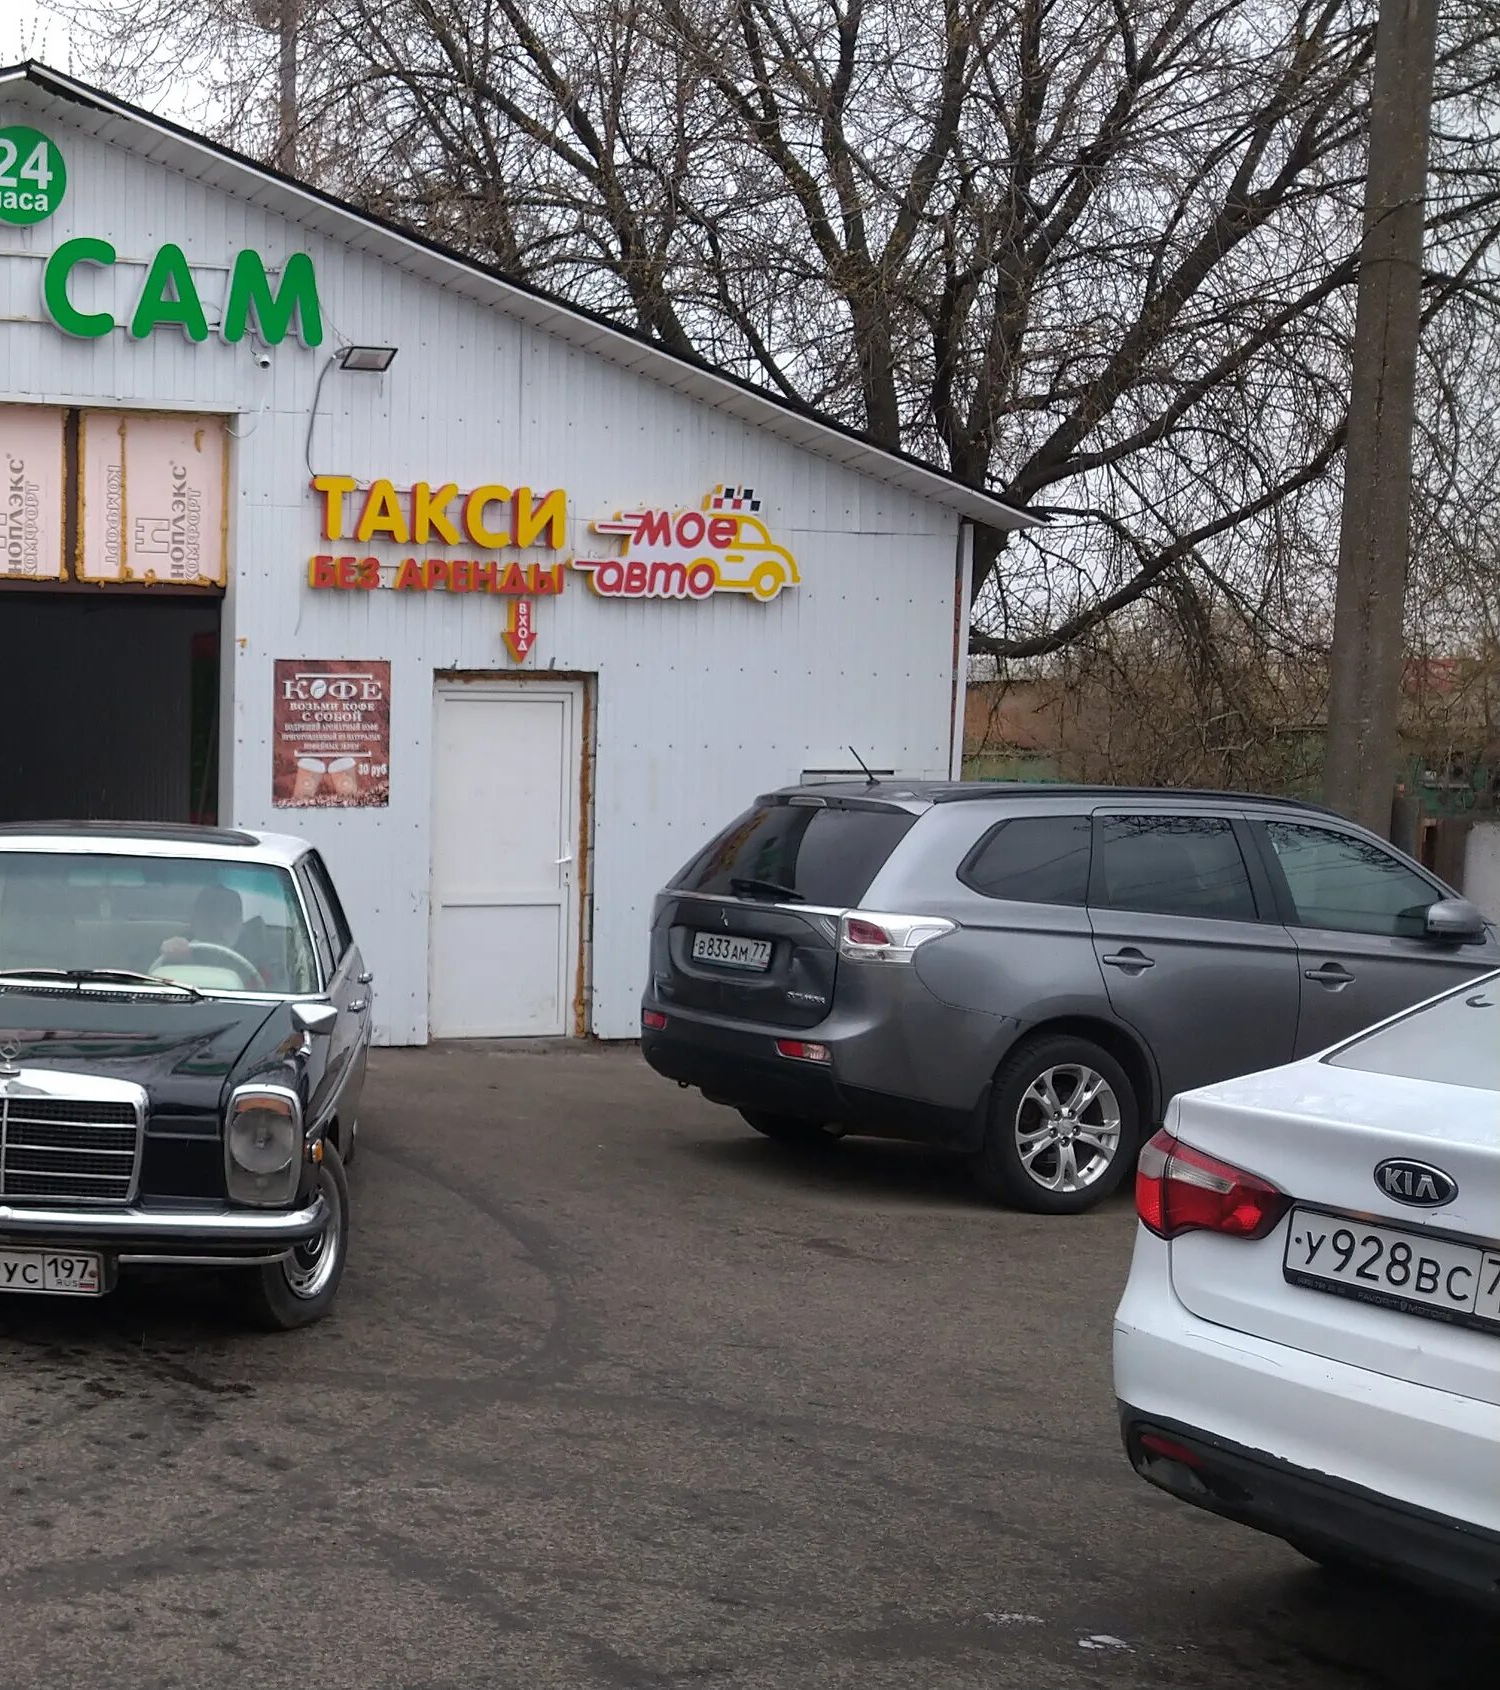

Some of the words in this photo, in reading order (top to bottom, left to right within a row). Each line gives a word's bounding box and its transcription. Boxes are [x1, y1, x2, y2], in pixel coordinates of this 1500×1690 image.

[43, 236, 323, 348] САМ
[171, 465, 187, 578] НОПЛЭКС
[310, 475, 566, 550] ТАКСИ
[309, 555, 380, 590] БЕЗ
[394, 558, 564, 595] АРЕНДЫ
[518, 602, 529, 651] ВХОД
[282, 679, 383, 700] КОФЕ
[289, 702, 339, 712] ВОЗЬМИ
[342, 702, 376, 712] КОФЕ
[302, 712, 311, 722] С
[314, 710, 363, 722] СОБОЙ
[698, 937, 749, 961] В833АМ
[752, 942, 767, 959] 77
[1384, 1167, 1439, 1200] KIA
[47, 1257, 90, 1279] 197
[1306, 1229, 1473, 1301] У928ВС
